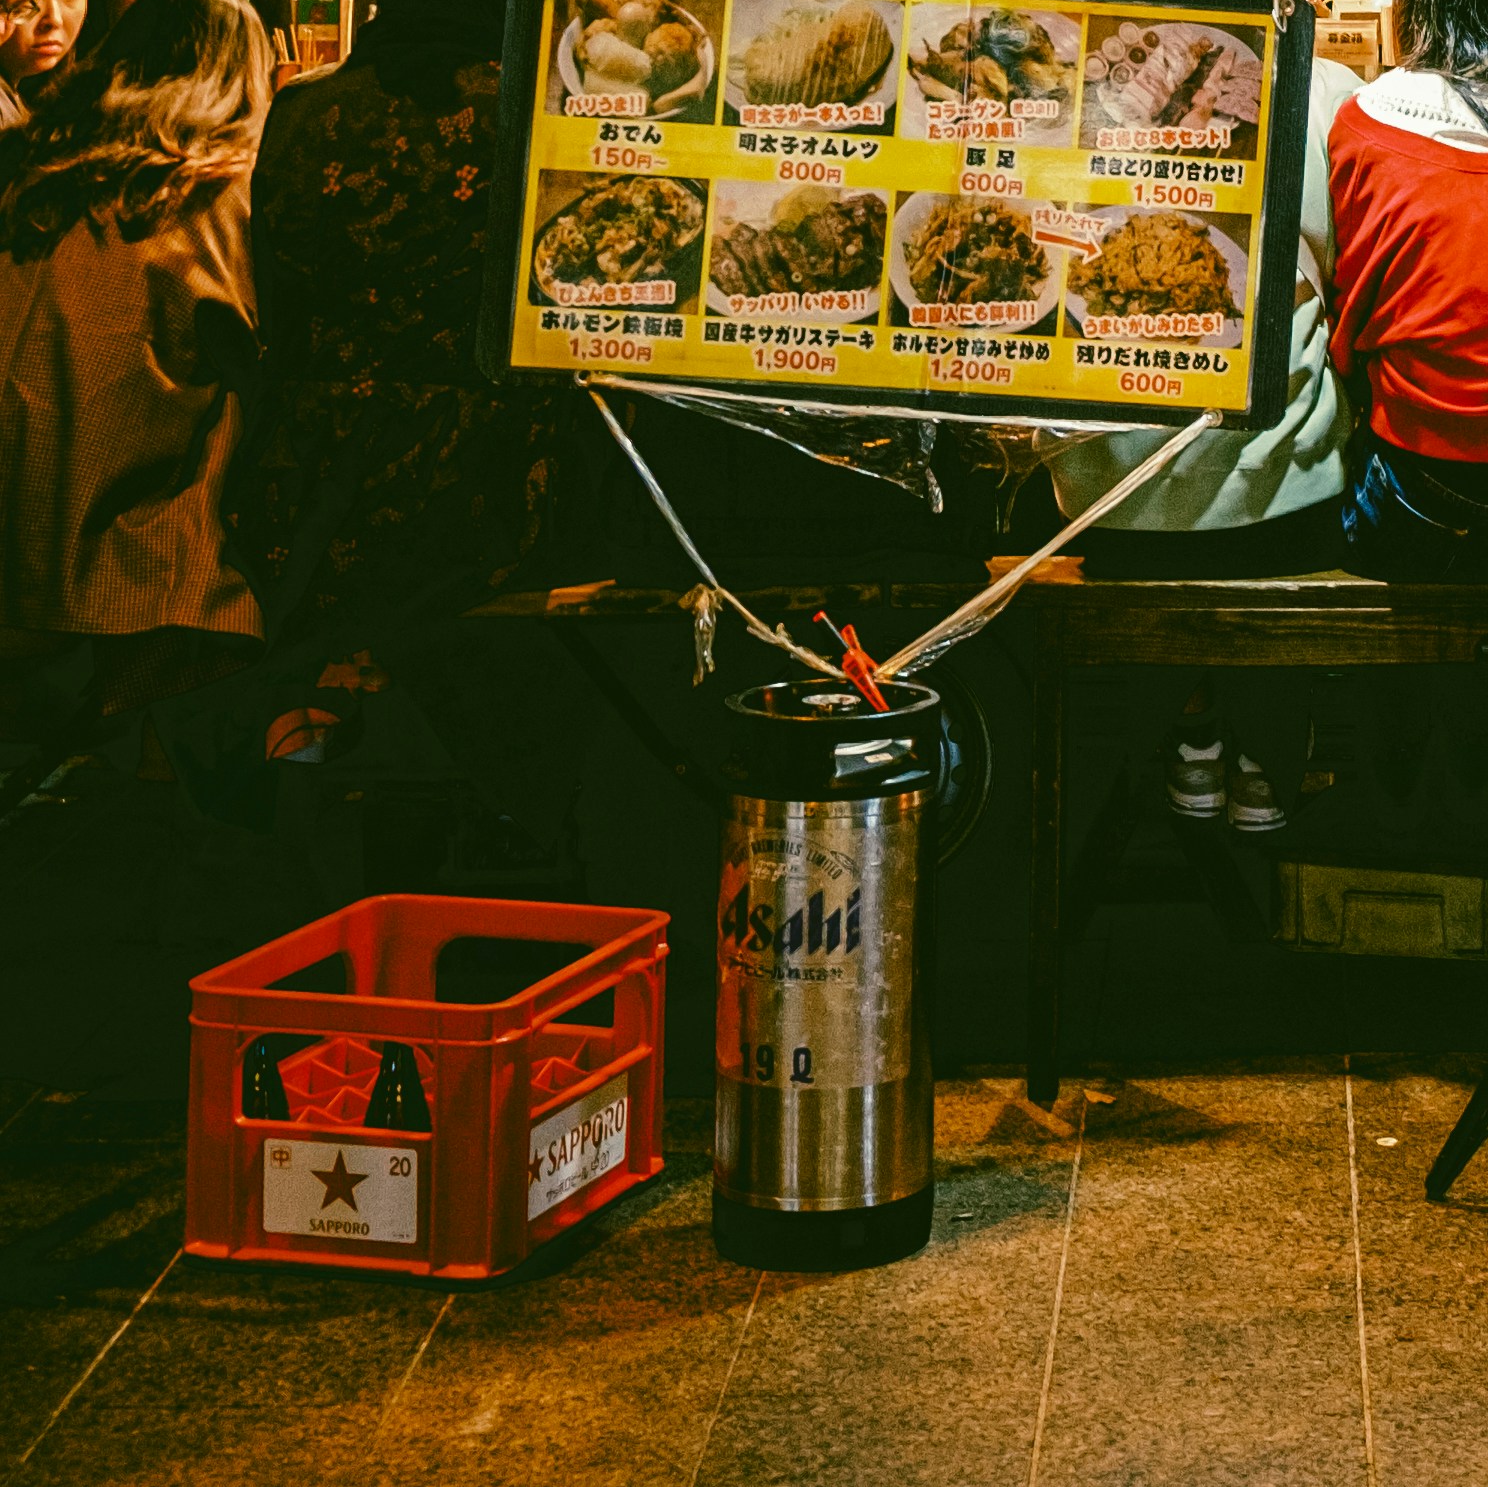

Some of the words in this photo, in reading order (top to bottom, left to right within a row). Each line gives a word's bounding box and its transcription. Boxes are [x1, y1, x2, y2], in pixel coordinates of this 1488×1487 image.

[599, 123, 662, 145] おでん
[738, 133, 879, 159] 明太子オムレツ
[779, 162, 842, 183] 800円
[961, 172, 1022, 195] 600円
[1134, 184, 1213, 208] 1,500円
[704, 322, 875, 350] 国産牛サガリステーキ
[569, 338, 652, 362] 1,300円
[754, 350, 836, 373] 1,900円
[1076, 345, 1229, 373] 残りだれ焼きめし
[930, 360, 1011, 383] 1,200円
[1119, 373, 1182, 396] 600円
[721, 883, 861, 955] Asahi
[740, 1044, 775, 1082] 19
[547, 1099, 625, 1176] SAPPORO
[389, 1155, 412, 1177] 20
[309, 1218, 370, 1235] SAPPORO
